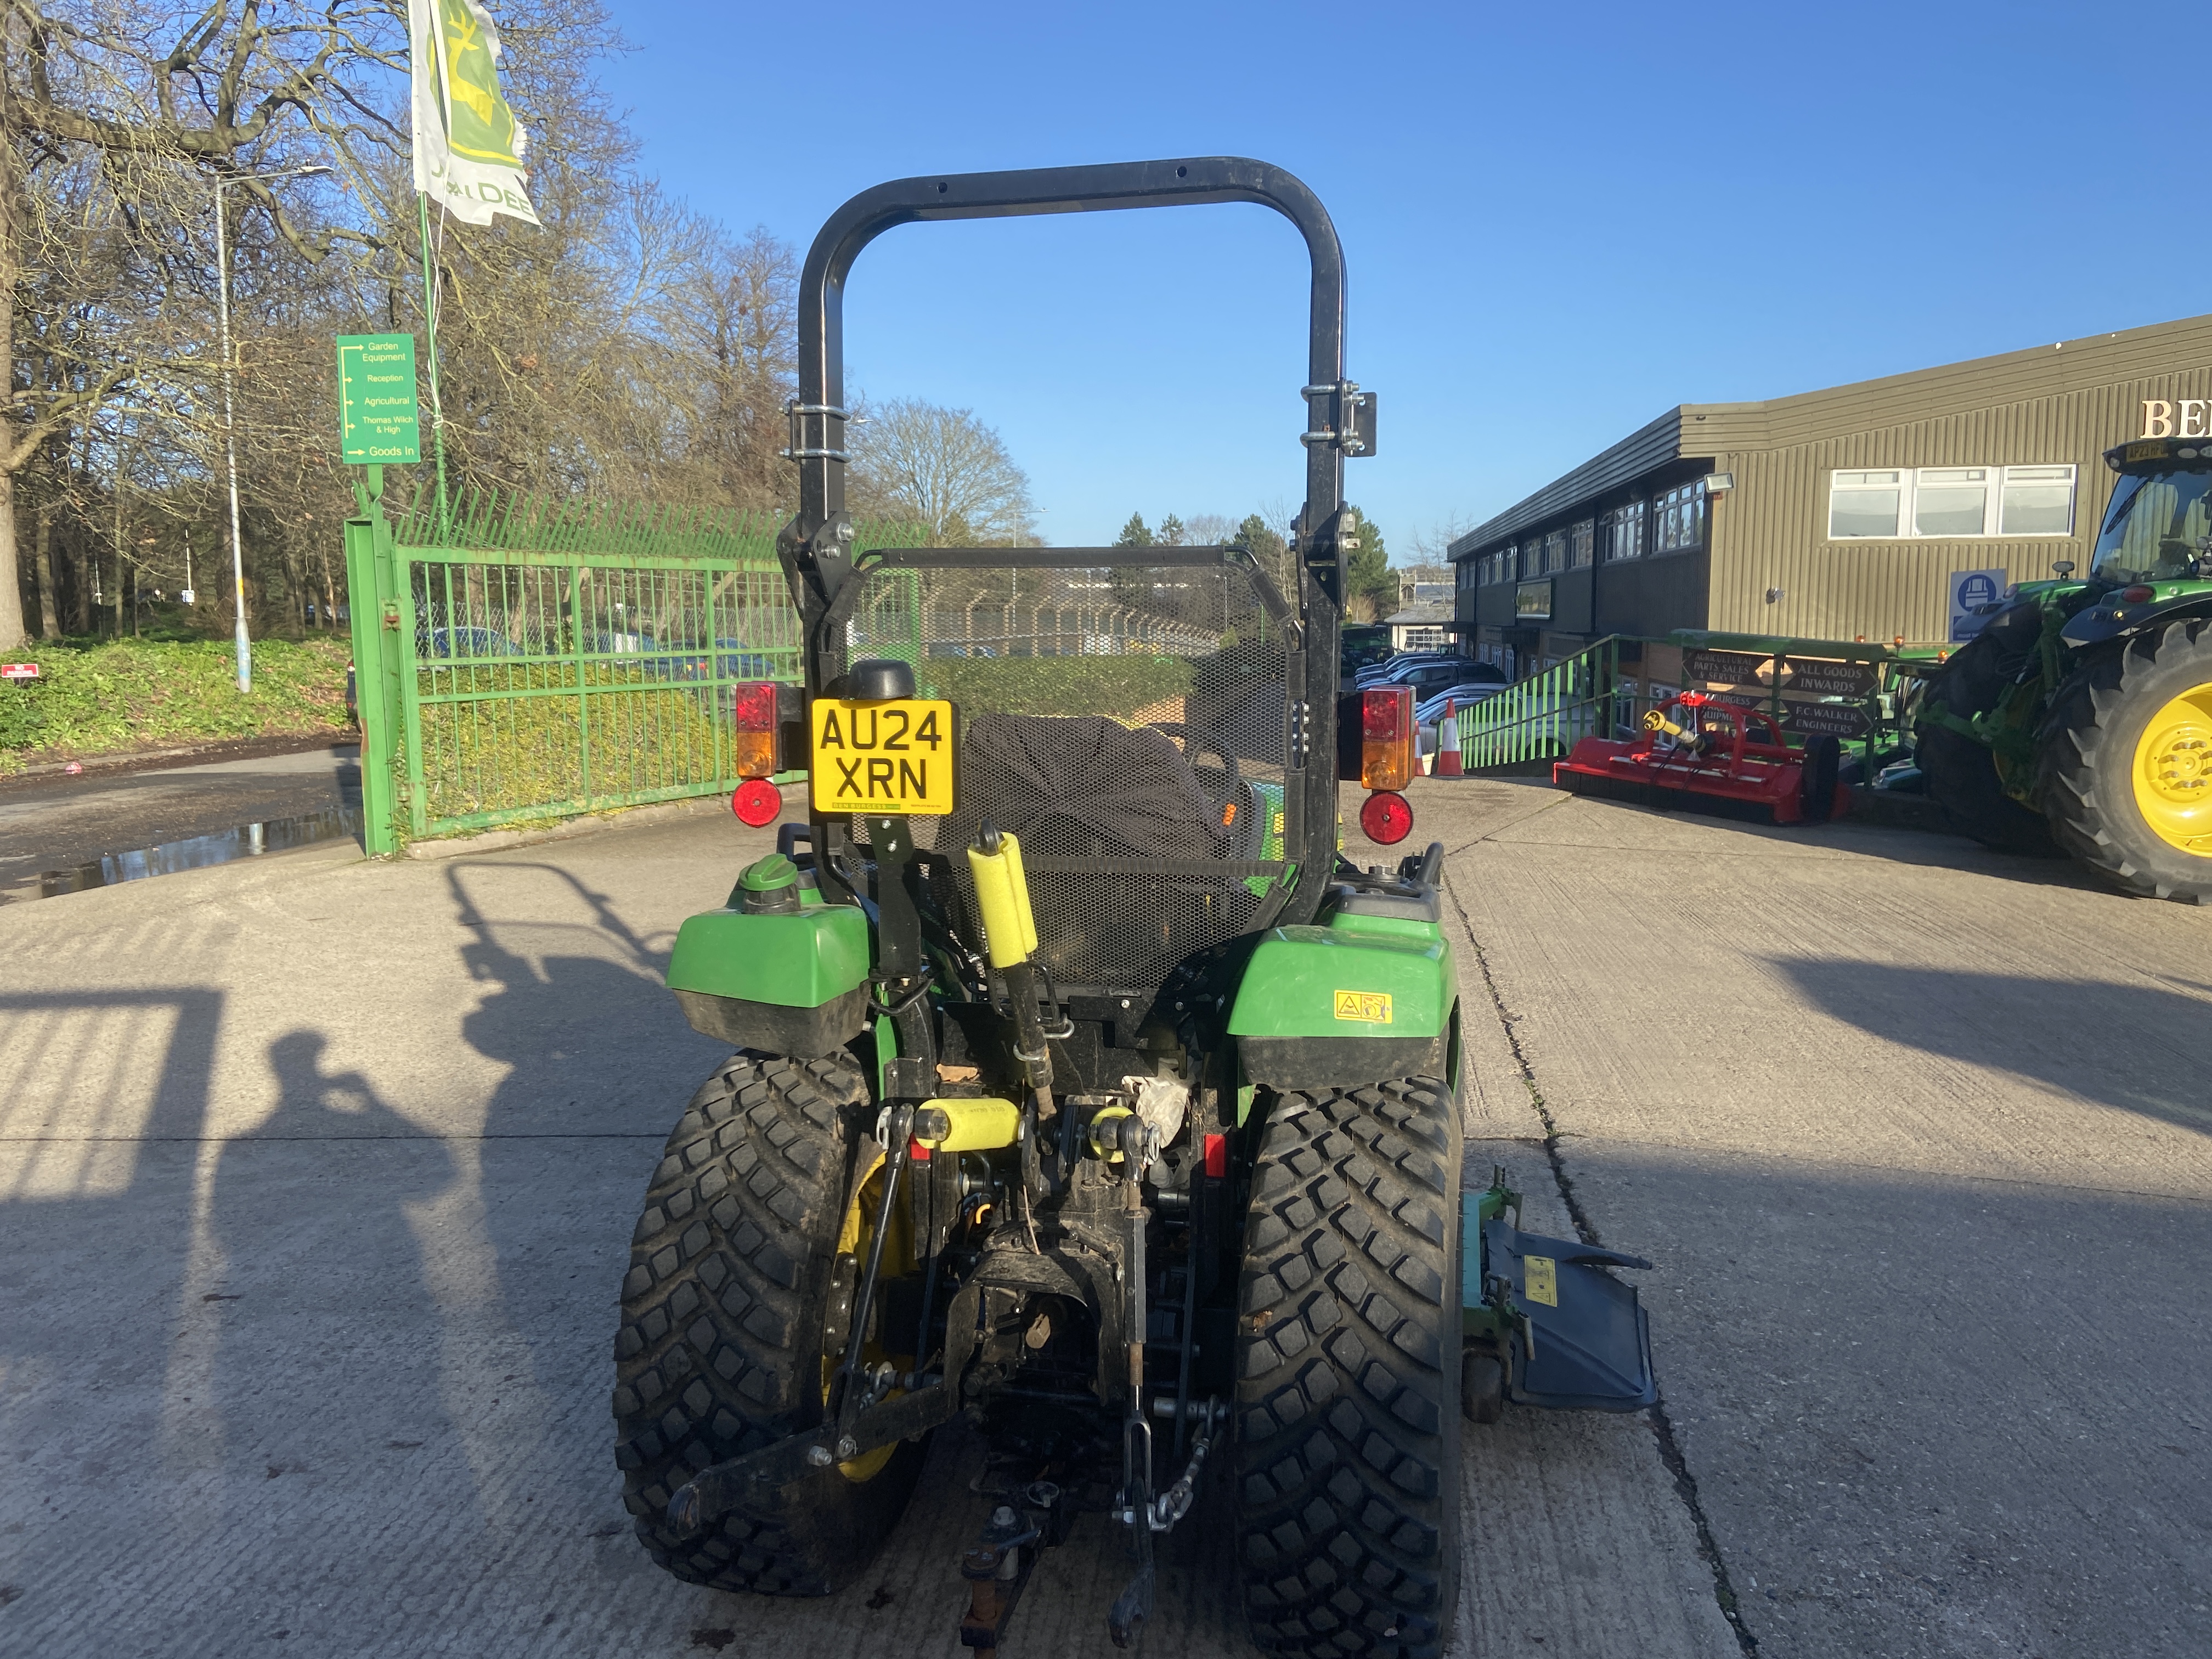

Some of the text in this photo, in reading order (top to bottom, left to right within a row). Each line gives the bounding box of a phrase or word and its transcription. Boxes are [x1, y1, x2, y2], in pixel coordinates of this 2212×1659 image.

[368, 342, 398, 351] Garden
[362, 353, 406, 363] Equipment
[367, 374, 403, 383] Reception
[364, 396, 409, 407] Agricultural
[2140, 399, 2212, 439] BE
[384, 425, 400, 435] High
[369, 446, 414, 456] Goods In
[1695, 653, 1753, 665] AGRICULTURAL
[1723, 664, 1749, 675] SALES
[1798, 664, 1863, 679] ALL GOODS
[1708, 672, 1743, 684] SERVICE
[1800, 678, 1856, 693] INWARDS
[1715, 693, 1751, 706] BURGESS
[1814, 708, 1858, 723] WALKER
[820, 709, 942, 751] AU24
[1796, 719, 1853, 734] ENGINEERS
[836, 757, 927, 799] XRN
